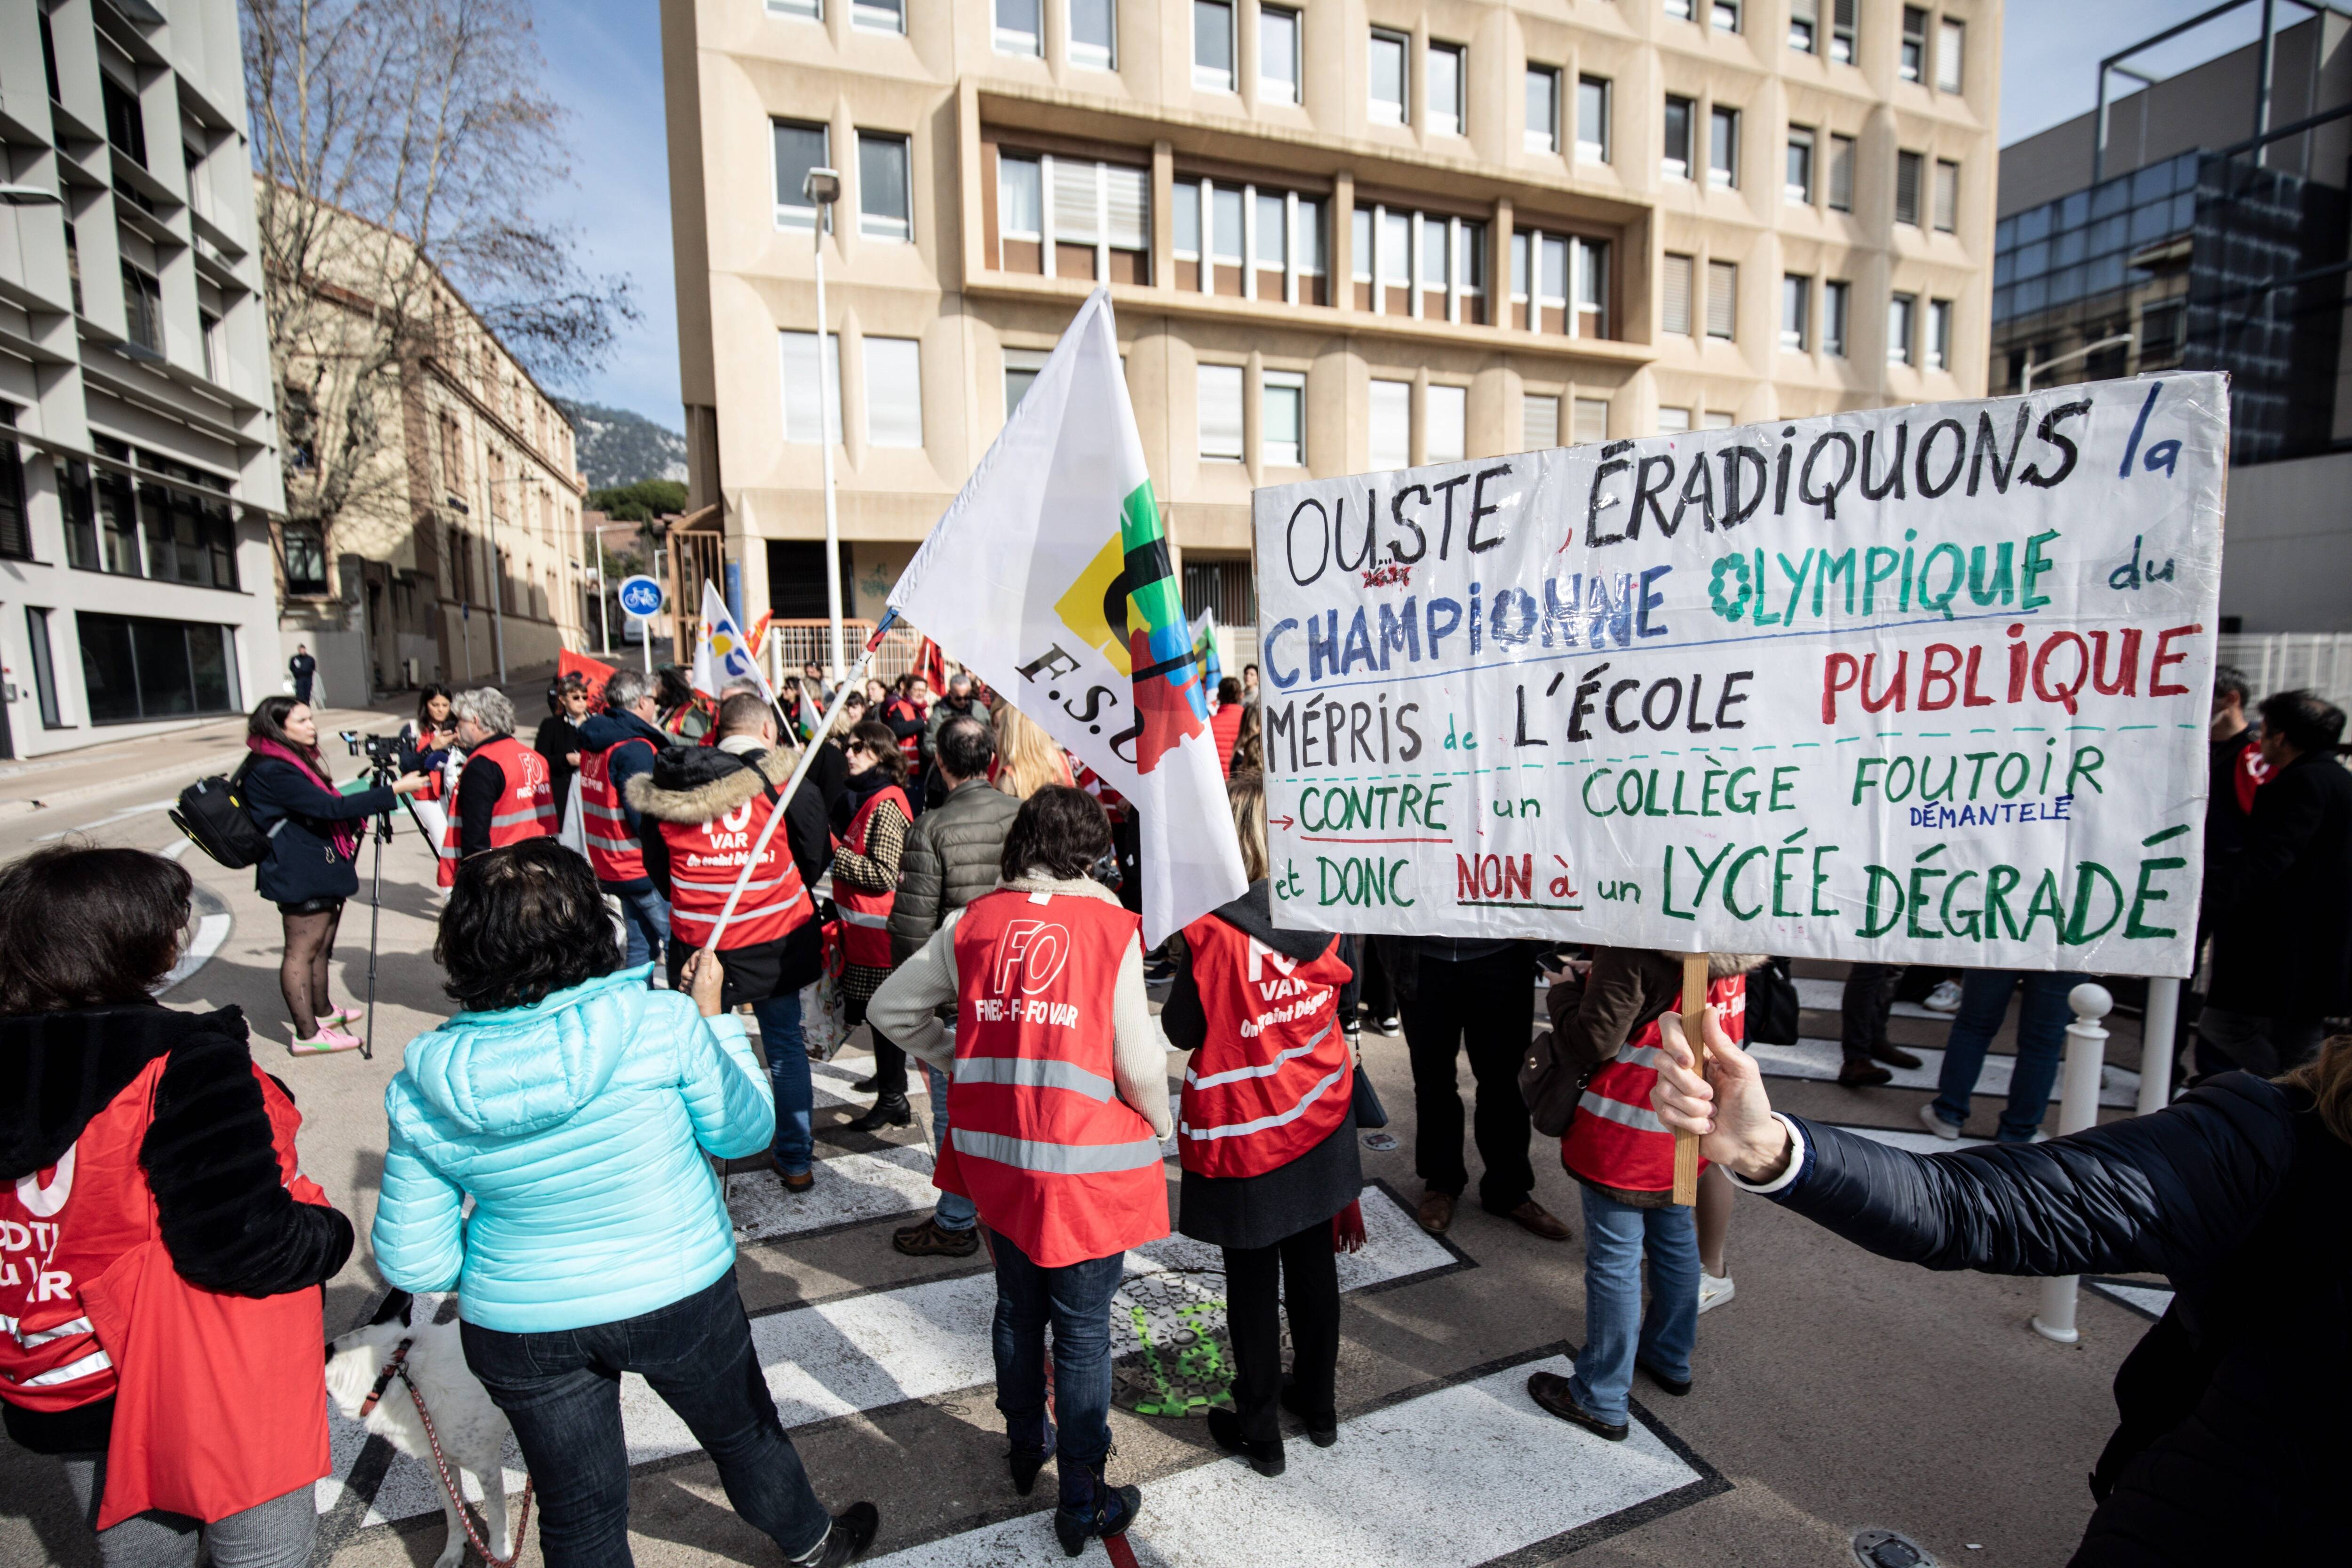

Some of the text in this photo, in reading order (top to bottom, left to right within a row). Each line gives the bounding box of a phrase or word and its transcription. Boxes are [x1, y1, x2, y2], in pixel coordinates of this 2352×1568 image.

[1287, 463, 1512, 587] OUSTE
[2119, 382, 2182, 479] la
[2109, 534, 2174, 590] du
[1444, 713, 1478, 750] de
[1514, 663, 1754, 747] L'ÉCOLE
[1300, 783, 1453, 832] CONTRE
[1494, 798, 1541, 818] un
[1582, 755, 1800, 817] COLLÈGE
[1910, 795, 2074, 829] DÉMANTELÉ
[709, 832, 748, 849] VAR
[1275, 824, 2190, 946] et DONC NON à un LYCÉE DÉGRADÉ
[994, 919, 1070, 995] FO
[1049, 1002, 1079, 1029] VAR
